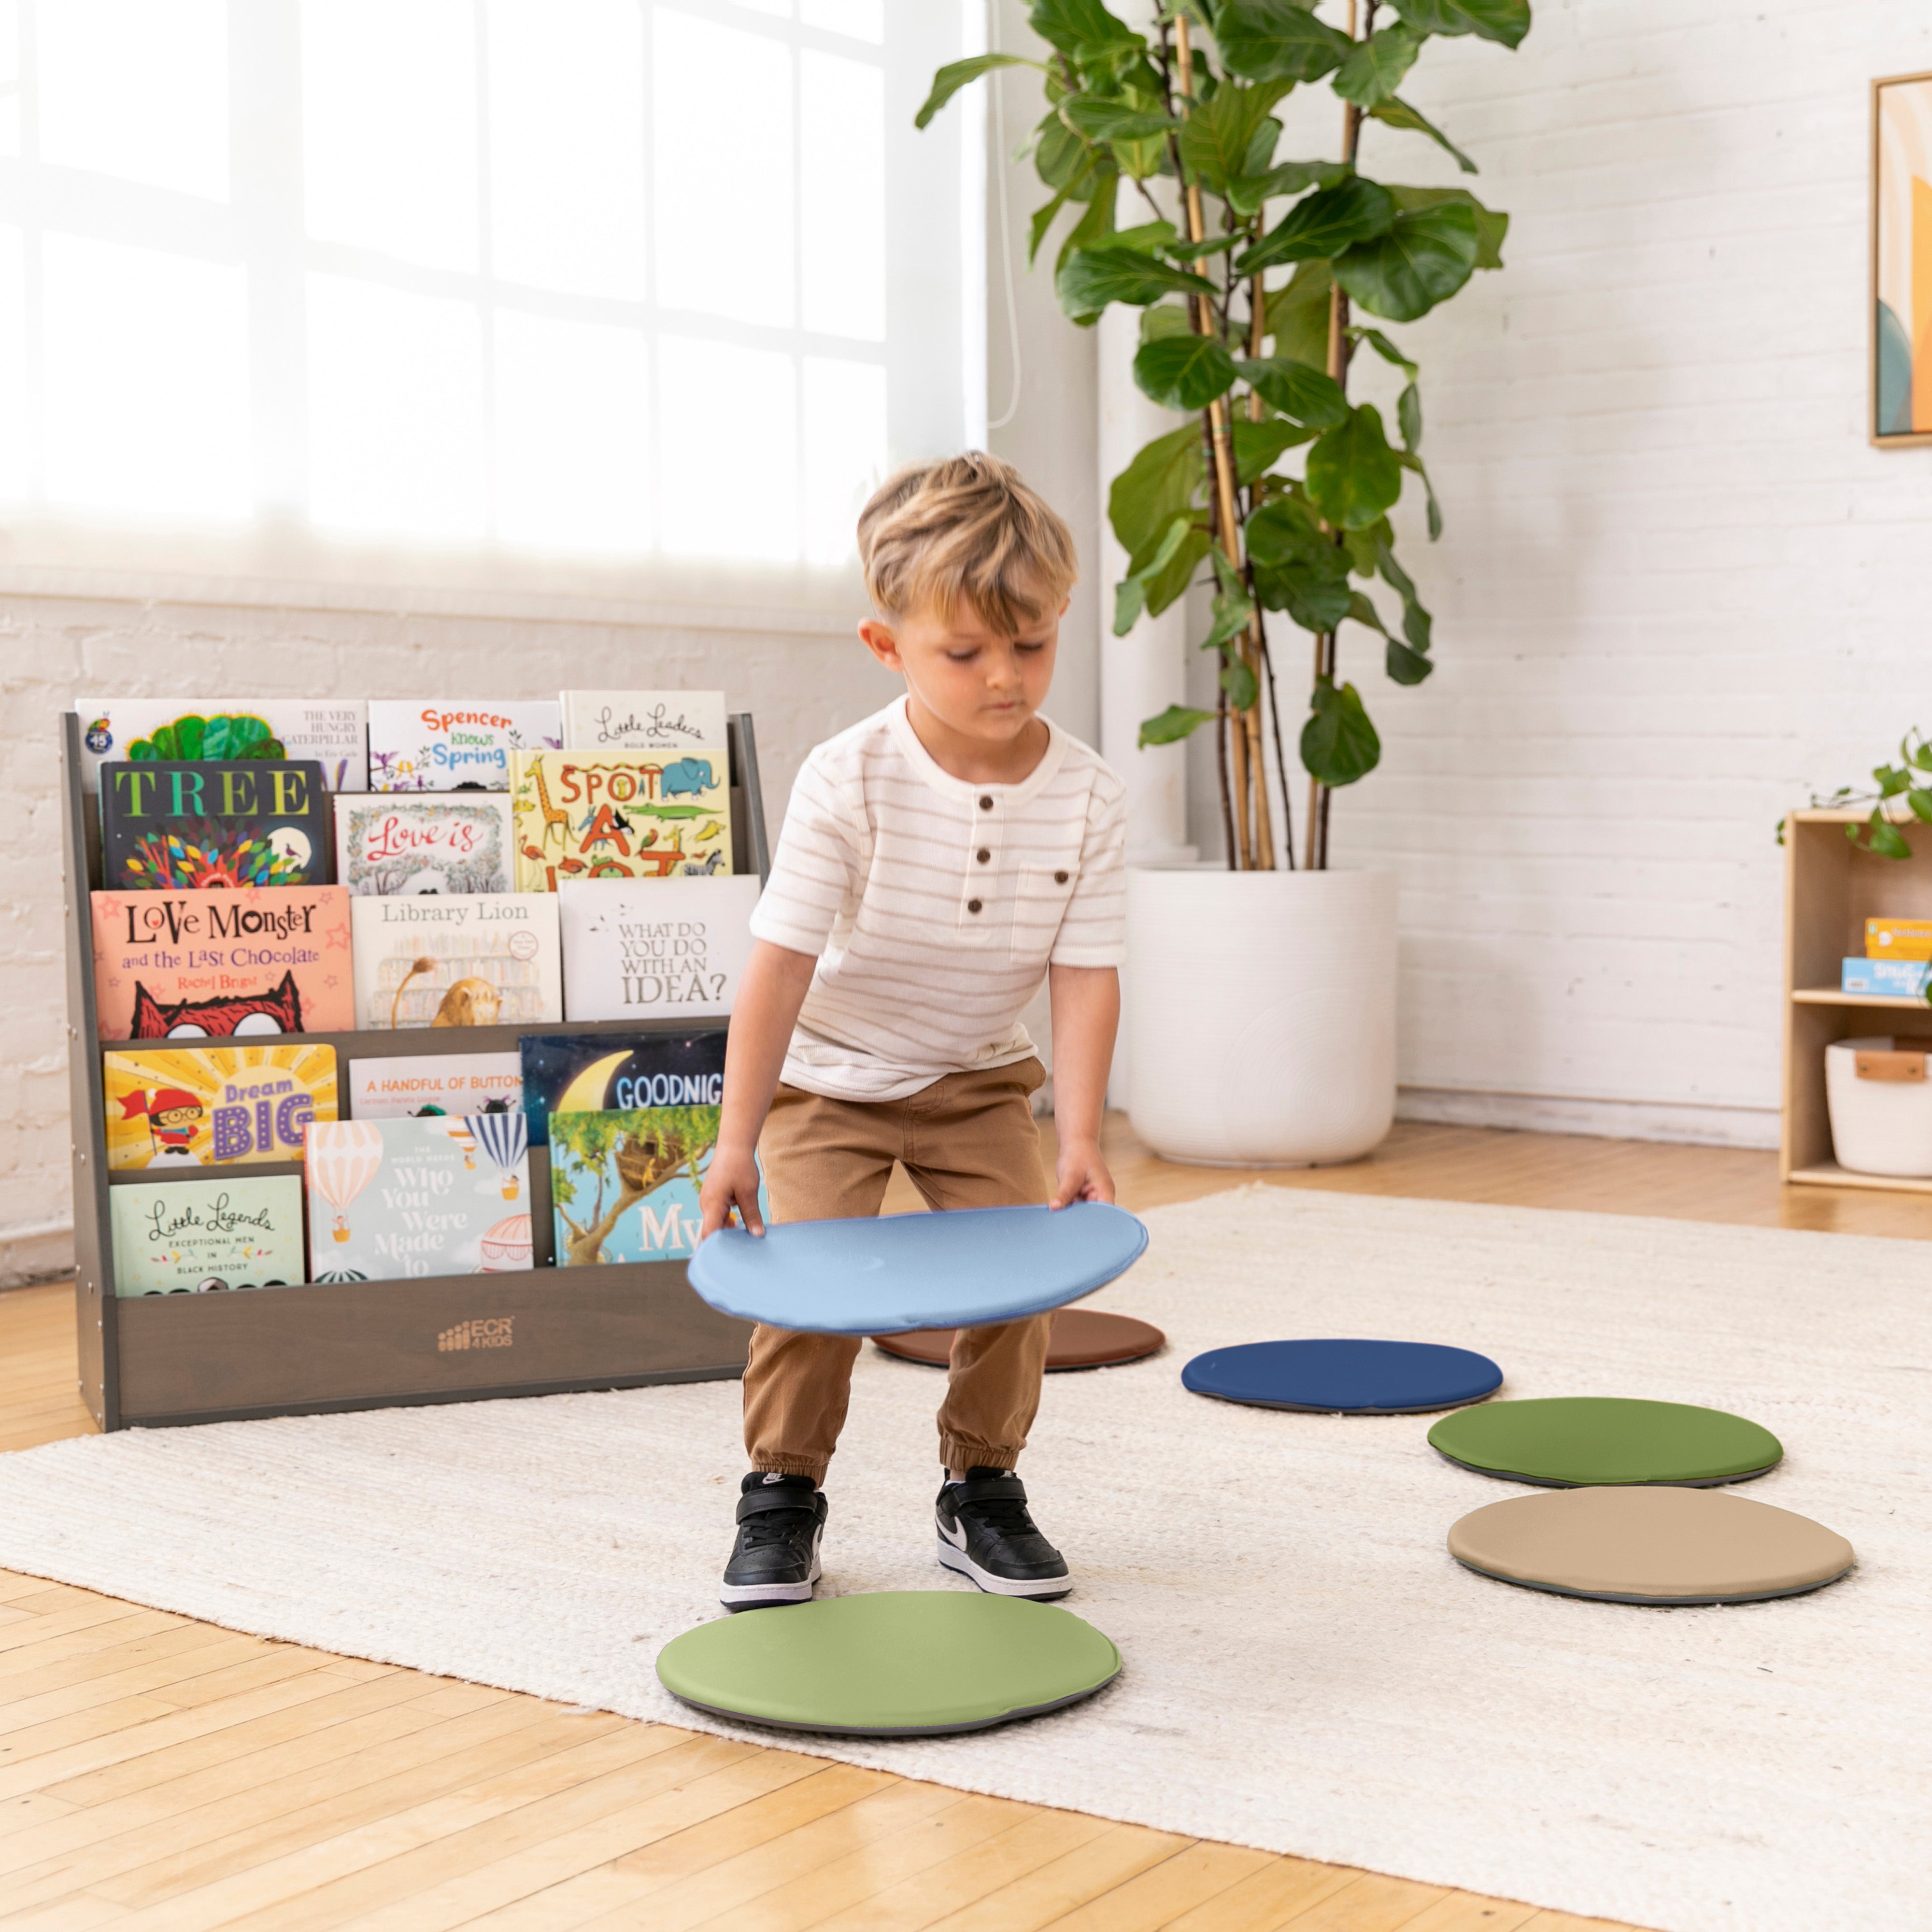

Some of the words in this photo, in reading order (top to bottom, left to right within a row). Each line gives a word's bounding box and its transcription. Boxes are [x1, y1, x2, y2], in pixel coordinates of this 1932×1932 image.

[303, 710, 326, 720] THE
[328, 710, 358, 720] VERY
[421, 709, 512, 733] Spencer
[594, 706, 645, 743] Little
[646, 703, 705, 741] Leaders
[283, 734, 358, 744] CATERPILLAR
[311, 723, 358, 732] HUNGRY
[432, 743, 506, 770] Spring
[115, 770, 309, 818] TREE
[560, 768, 663, 804] SPOT
[367, 817, 447, 861] Love
[449, 822, 483, 852] is
[579, 804, 630, 856] A
[208, 904, 317, 940] Monster
[382, 904, 469, 925] Library
[476, 902, 529, 921] Lion
[618, 923, 673, 938] WHAT
[677, 922, 706, 937] DO
[122, 953, 148, 968] and
[154, 951, 182, 968] the
[619, 939, 665, 957] YOU
[674, 938, 707, 955] DO
[621, 959, 673, 974] WITH
[681, 957, 708, 973] AN
[621, 973, 727, 1004] IDEA?
[225, 1079, 294, 1104] Dream
[367, 1080, 377, 1093] A
[381, 1078, 443, 1092] HANDFUL
[448, 1077, 466, 1090] OF
[616, 1073, 724, 1110] GOODNIG
[212, 1093, 315, 1161] BIG
[394, 1167, 455, 1195] Who
[381, 1187, 430, 1208] You
[145, 1200, 205, 1241] Little
[206, 1192, 275, 1232] Legends
[402, 1211, 468, 1231] Were
[169, 1238, 230, 1248] EXCEPTIONAL
[374, 1231, 445, 1262] Made
[177, 1266, 204, 1275] BLACK
[208, 1262, 248, 1272] HISTORY
[470, 1318, 512, 1337] ECR
